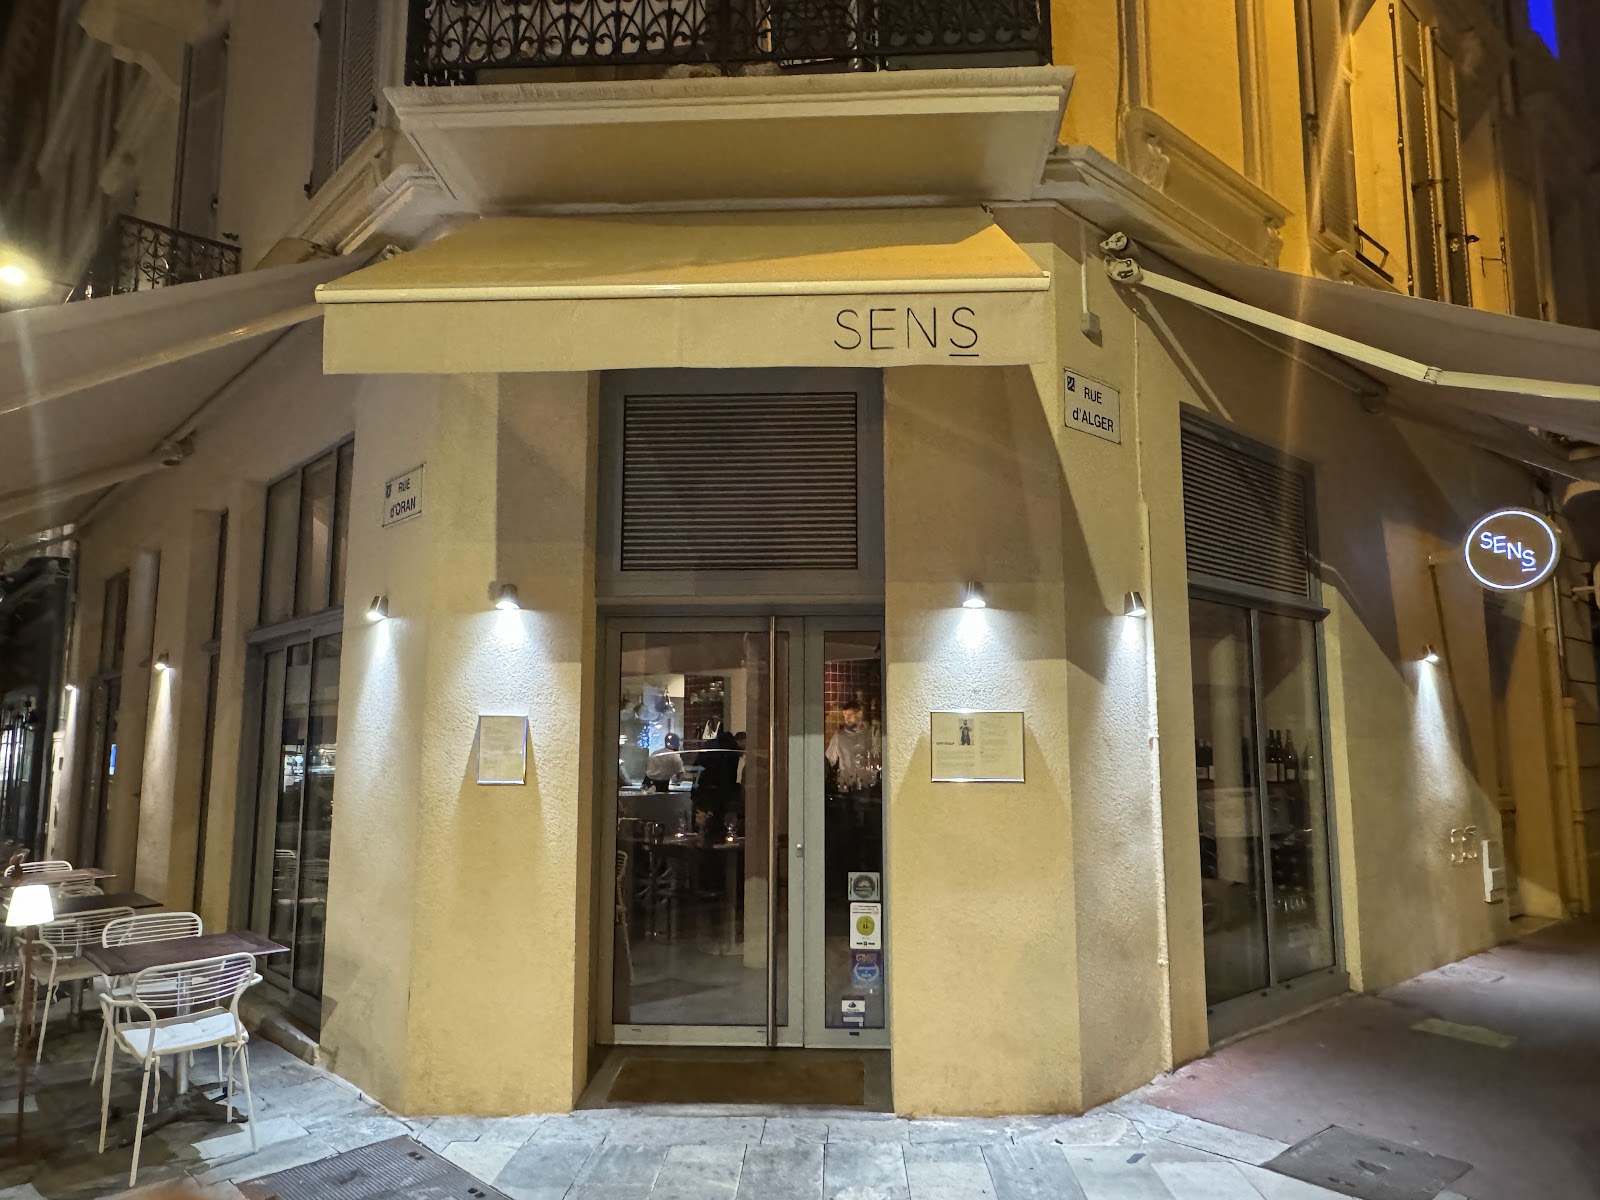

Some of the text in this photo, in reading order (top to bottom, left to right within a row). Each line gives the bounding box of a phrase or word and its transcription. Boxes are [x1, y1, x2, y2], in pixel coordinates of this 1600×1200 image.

[834, 306, 979, 357] SENS
[1083, 386, 1103, 405] RUE
[1072, 407, 1114, 433] d'ALGER
[398, 478, 411, 493] RUE
[1479, 531, 1537, 573] SENS
